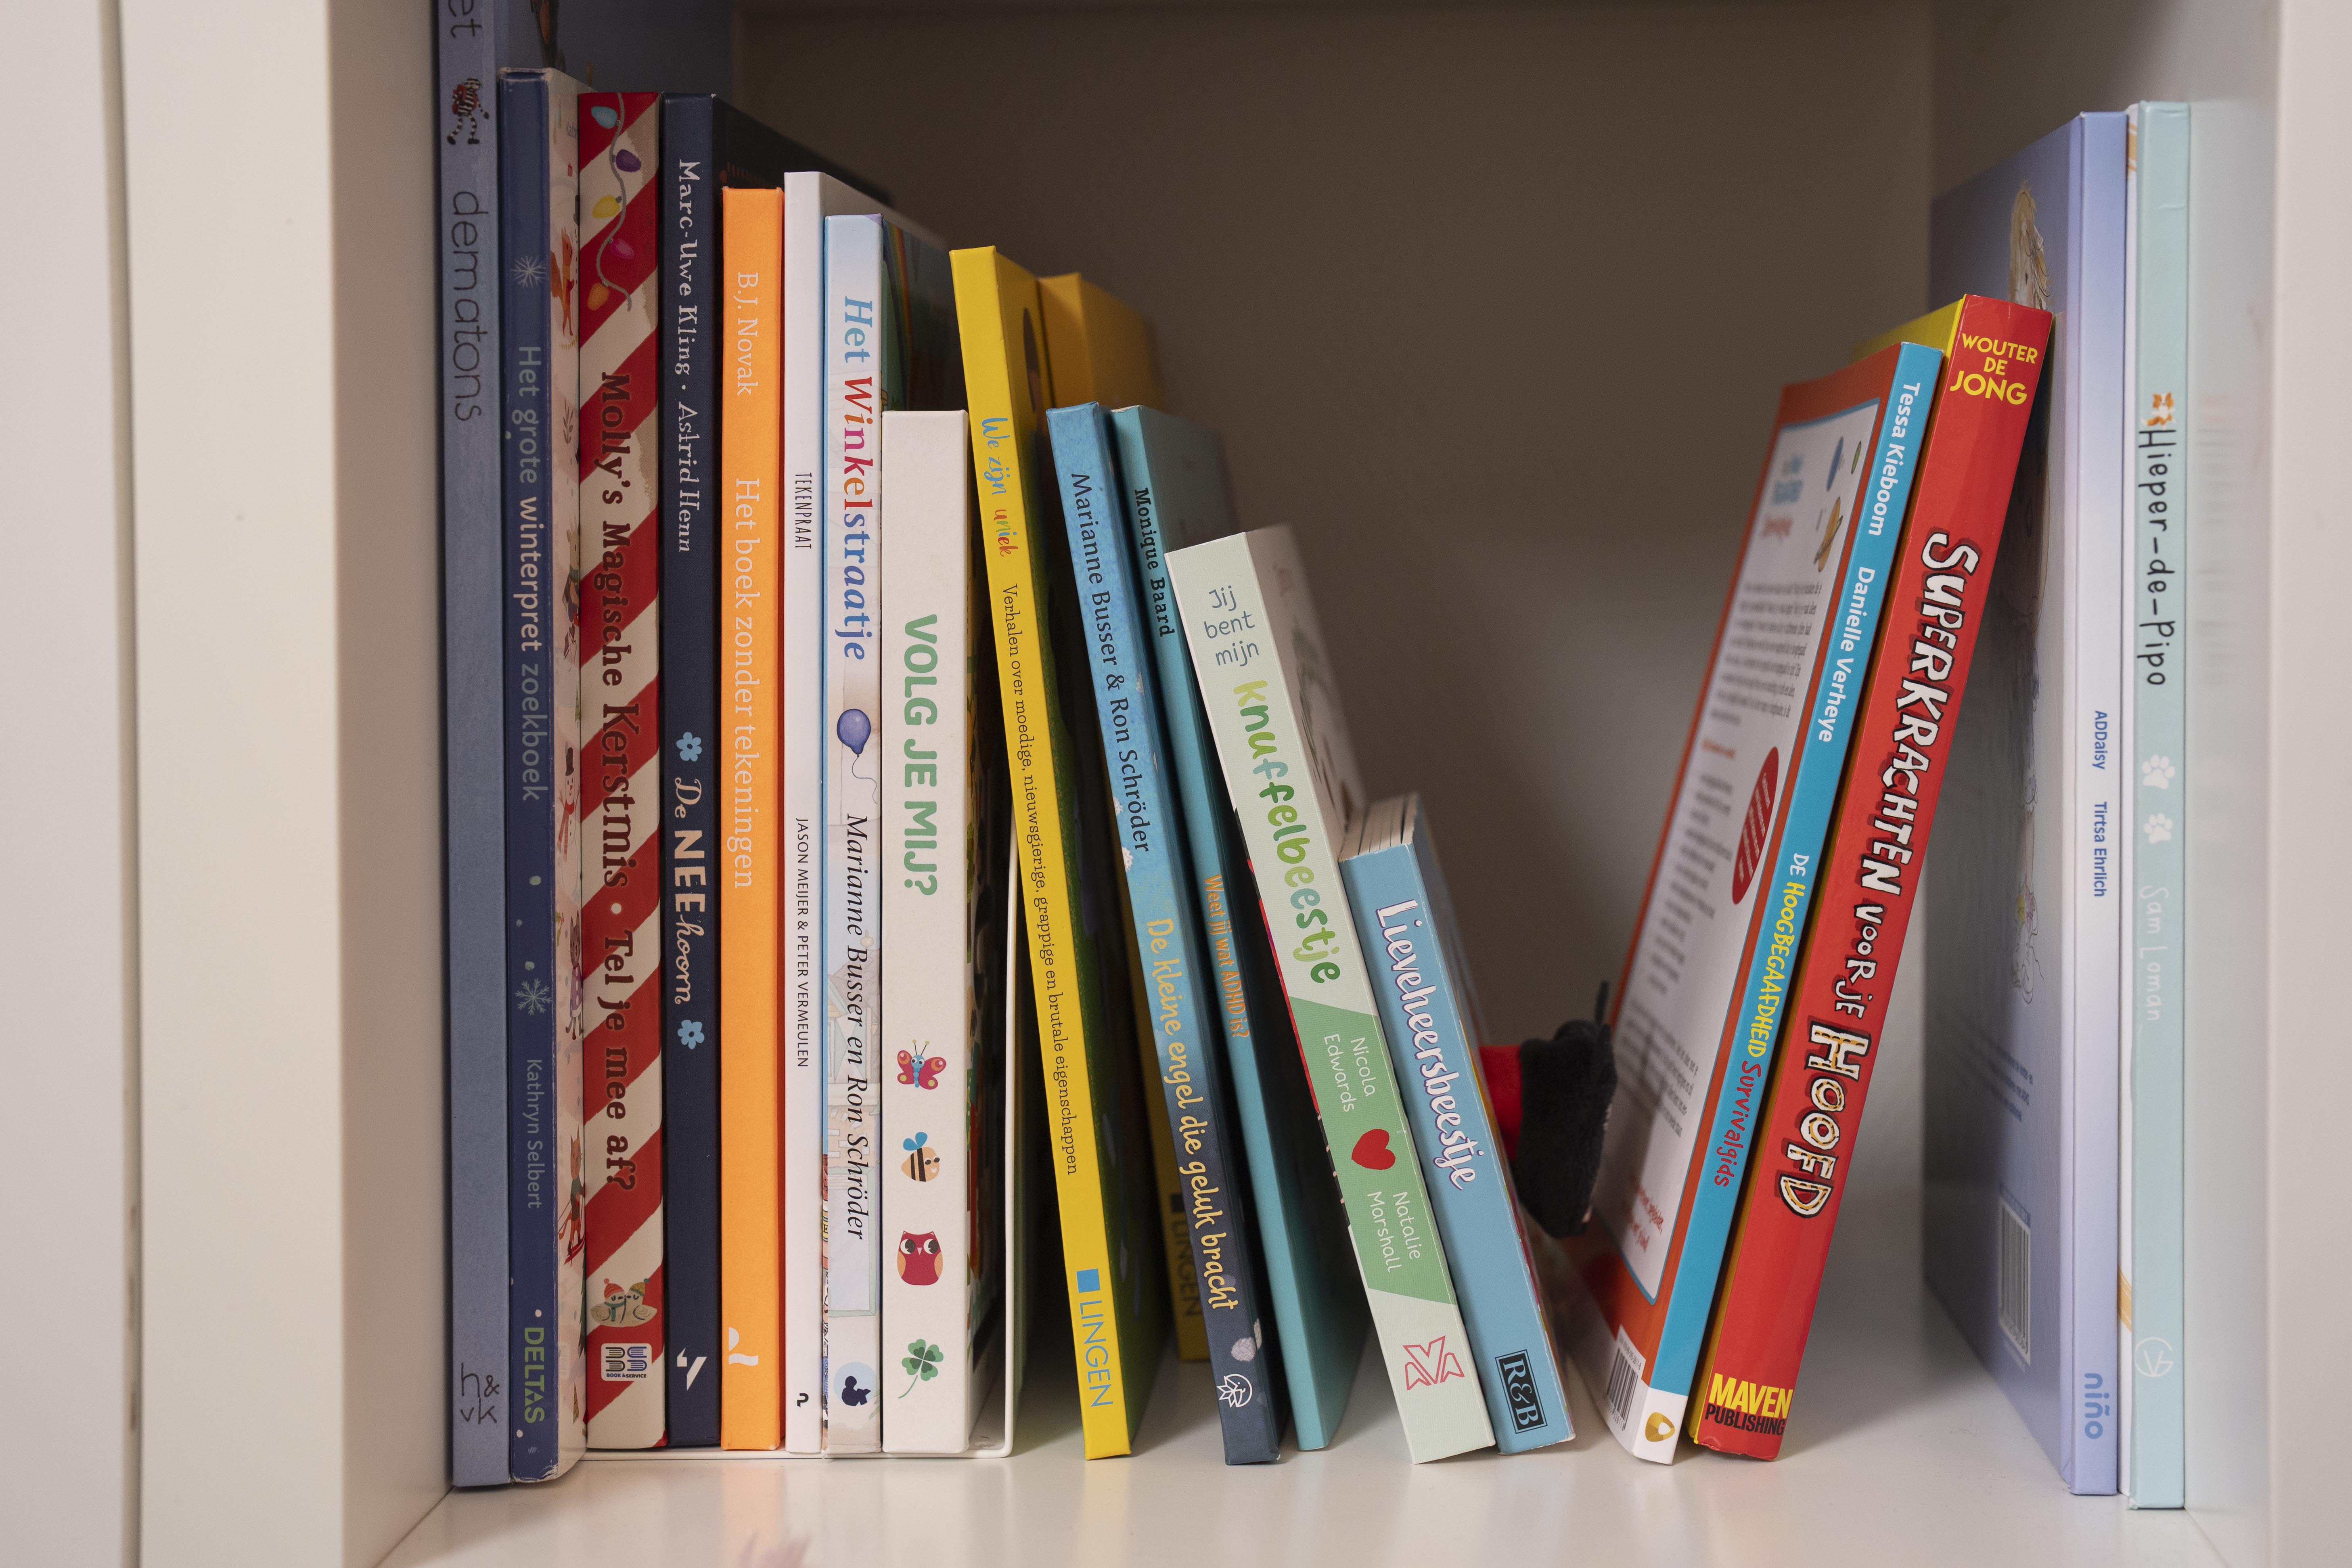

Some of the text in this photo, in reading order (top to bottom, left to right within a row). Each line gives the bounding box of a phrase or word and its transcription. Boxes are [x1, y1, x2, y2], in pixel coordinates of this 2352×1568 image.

[451, 191, 488, 421] dematons
[675, 159, 700, 553] Marc-Uwe Kling Astrid Henn
[733, 272, 759, 396] B.J. Novak
[1961, 333, 2038, 364] WOUTER
[1983, 357, 2008, 376] DE
[1950, 370, 2028, 405] JONG
[795, 472, 812, 550] TEKENPRAAT
[835, 296, 873, 660] Het Winkelstraatje
[981, 417, 1019, 558] We zijn uniek
[512, 347, 548, 801] Het grote winterpret zoekboek
[1134, 487, 1175, 637] Monique Baard
[1208, 584, 1237, 611] Jij
[1818, 382, 1921, 743] Tessa Kieboom Danielle Verheye
[2137, 429, 2177, 686] Hieper-de-Pipo
[593, 372, 640, 888] Molly's Magische Kerstmis
[726, 477, 761, 889] Het boek zonder tekeningen
[1071, 473, 1150, 853] Marianne Busser & Ron Schröder
[1204, 610, 1256, 639] bent
[1215, 641, 1260, 667] mijn
[674, 777, 702, 819] De
[904, 613, 938, 896] VOLG JE MIJ?
[2092, 710, 2108, 770] ADDaisy
[1002, 583, 1078, 1176] Verhalen over moedige, nieuwsgierige, grappige en brutale eigenschappen
[1789, 852, 1810, 877] DE
[2094, 801, 2107, 898] Tirtsa Ehrlich
[795, 817, 809, 1068] JASON MEIJER & PETER VERMEULEN
[1203, 874, 1251, 1038] Weet jij wat ADHD is?
[1748, 881, 1806, 1058] HOOGBEGAAFDHEID
[2139, 885, 2169, 1021] Sam Loman
[597, 929, 636, 1191] Tel je mee af?
[847, 813, 869, 1241] Marianne Busser en Ron Schröder
[1324, 1033, 1357, 1113] Edwards
[1350, 1037, 1377, 1097] Nicola
[1375, 899, 1485, 1191] Lieveheersbeestje
[522, 1059, 546, 1208] Kathryn Selbert
[1147, 918, 1239, 1311] De kleine engel die geluk bracht
[1714, 1060, 1762, 1187] Survivalgids
[1778, 1020, 1873, 1219] HOOFD
[1366, 1191, 1402, 1273] Marshall
[1392, 1191, 1421, 1260] Natalie
[524, 1327, 545, 1423] DELTAS
[1079, 1300, 1114, 1407] LINGEN
[1502, 1357, 1540, 1427] R&B
[1708, 1373, 1793, 1419] MAVEN
[2084, 1373, 2110, 1440] niño
[1704, 1403, 1786, 1436] PUBLISHING
